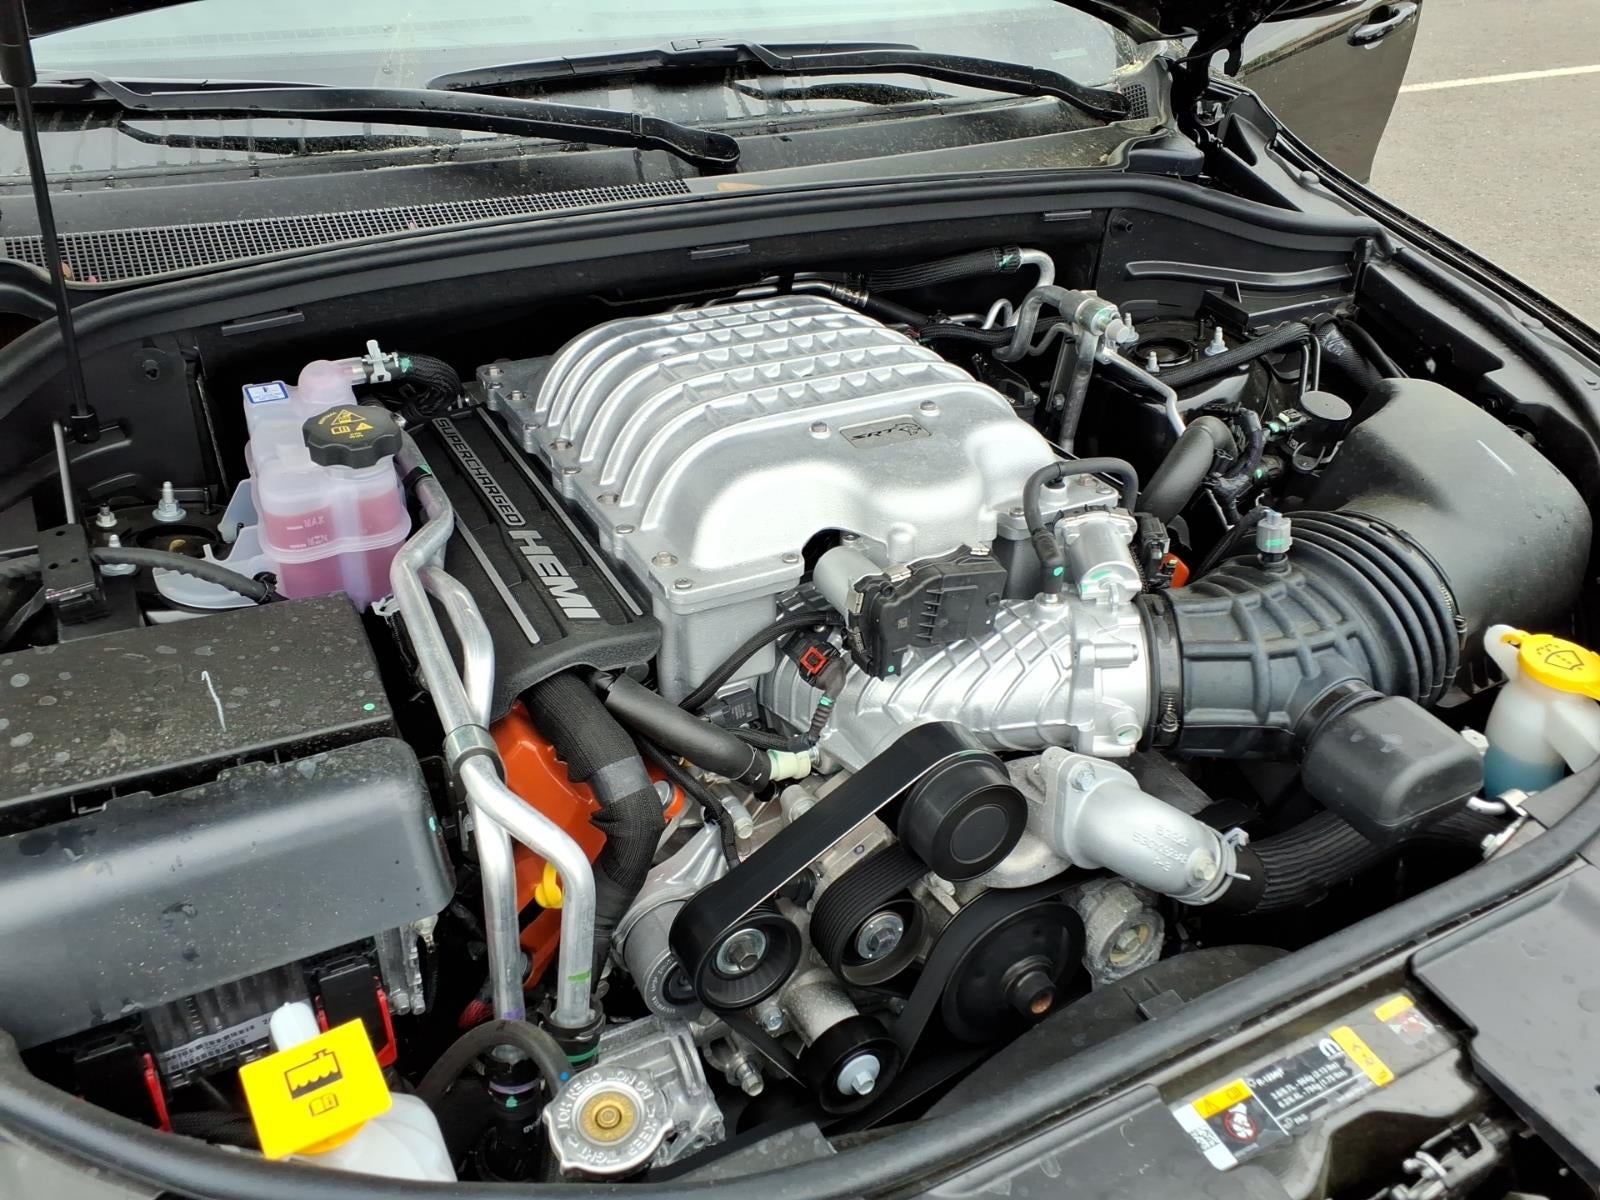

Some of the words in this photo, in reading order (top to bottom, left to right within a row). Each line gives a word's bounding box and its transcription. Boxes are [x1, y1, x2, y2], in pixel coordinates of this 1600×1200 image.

[851, 427, 896, 441] SRT
[435, 419, 523, 524] SUPERCHARGED
[304, 515, 326, 528] MAX
[307, 534, 328, 546] MIN
[508, 530, 601, 618] HEMI
[566, 1072, 602, 1100] OPEN
[607, 1070, 638, 1085] NOT
[636, 1081, 655, 1100] DO
[558, 1102, 572, 1129] HOT
[628, 1119, 657, 1156] KEEP
